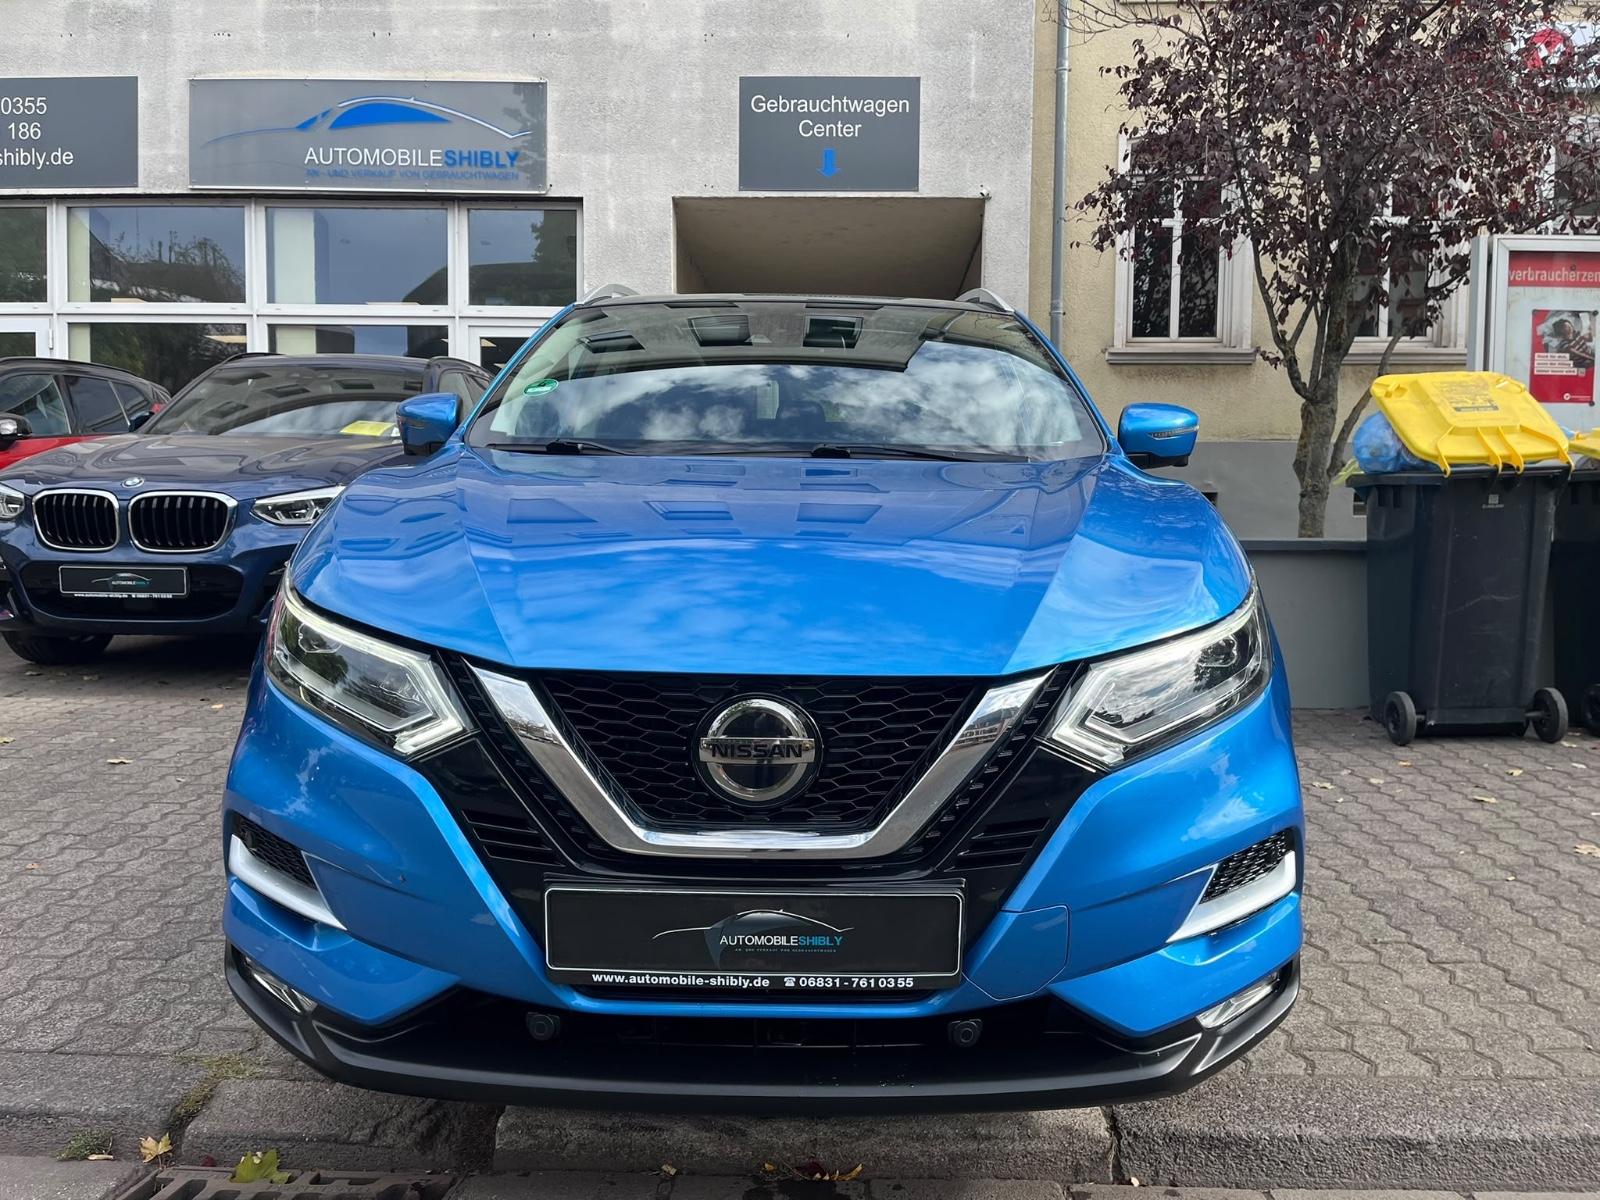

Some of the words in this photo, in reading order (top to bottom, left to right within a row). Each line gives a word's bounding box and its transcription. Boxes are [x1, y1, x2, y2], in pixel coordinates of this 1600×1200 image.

[0, 96, 48, 115] 0355
[750, 94, 910, 117] Gebrauchtwagen
[8, 122, 42, 140] 186
[798, 119, 862, 137] Center
[711, 743, 803, 758] NISSAN
[592, 973, 770, 988] www.automobile-shibly.de
